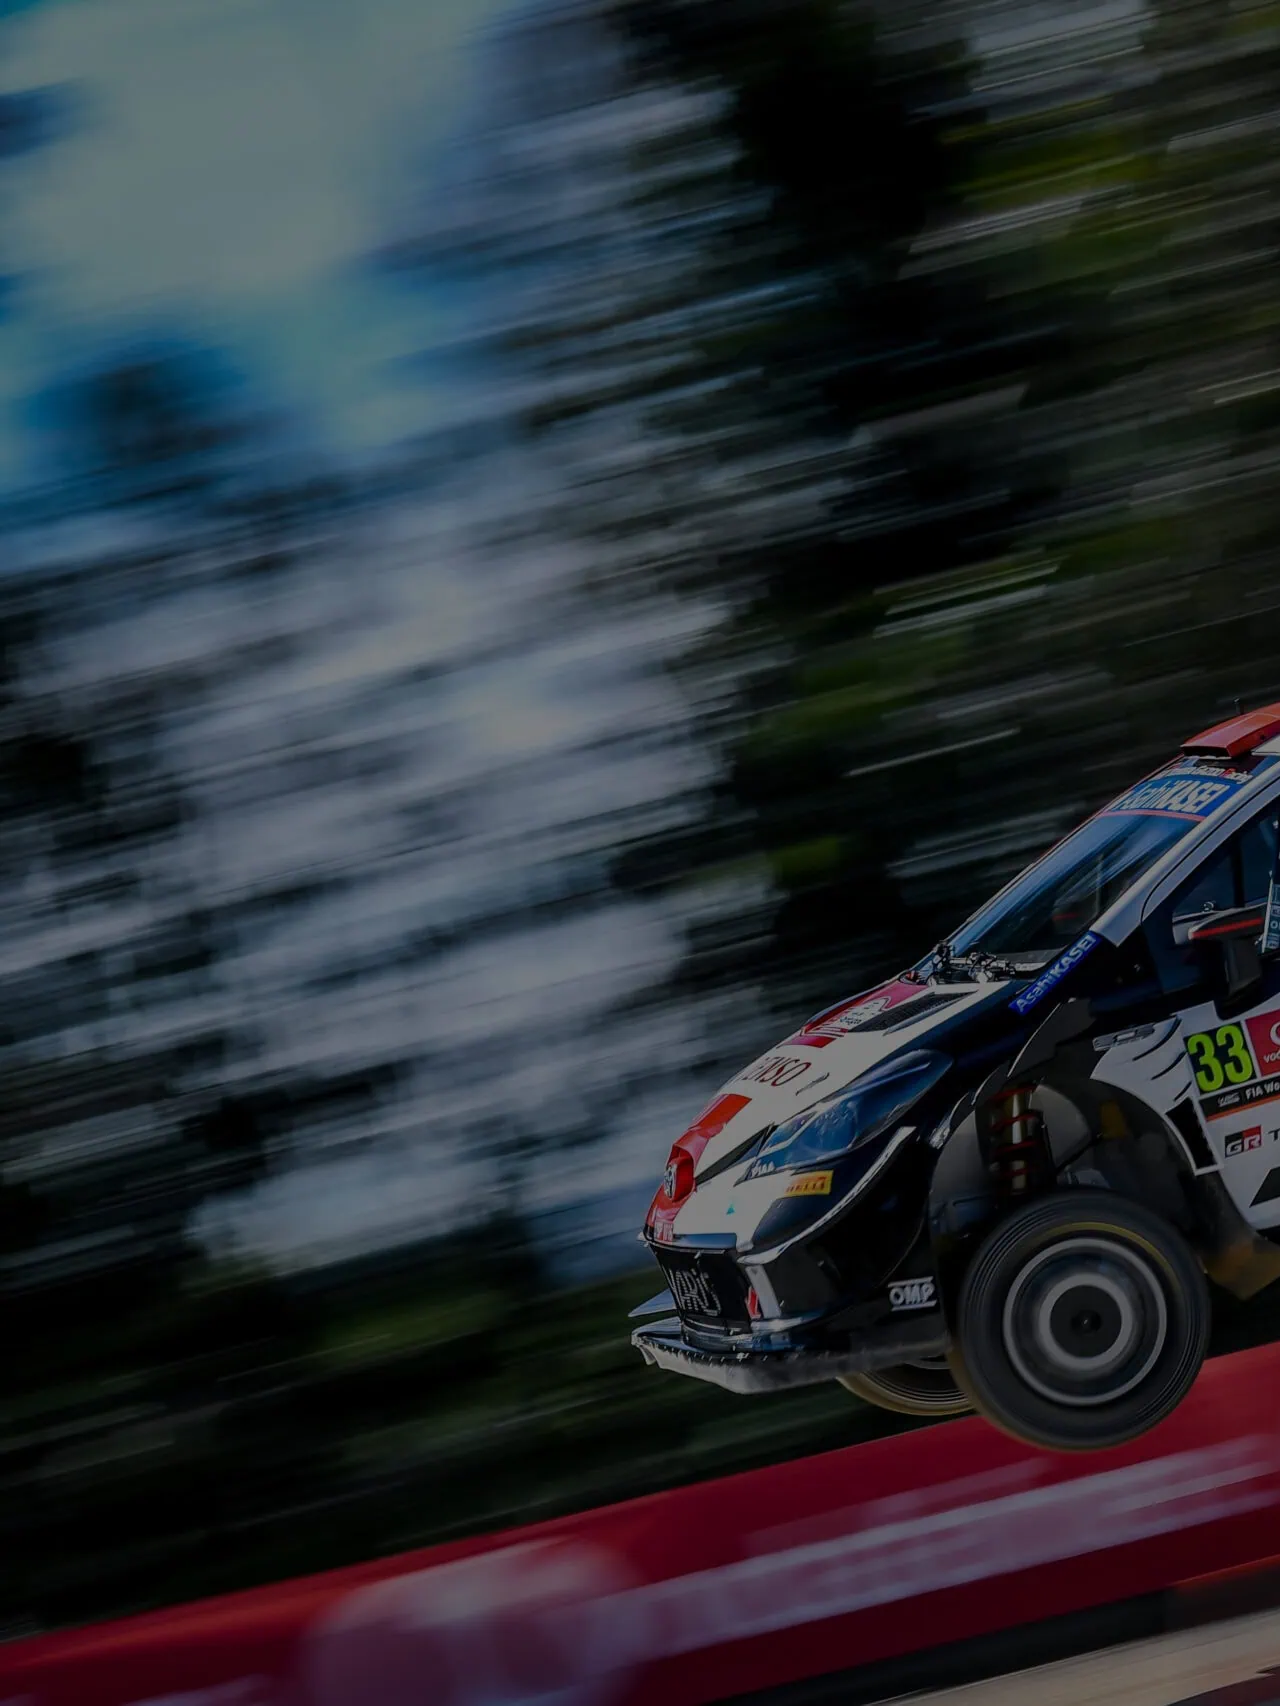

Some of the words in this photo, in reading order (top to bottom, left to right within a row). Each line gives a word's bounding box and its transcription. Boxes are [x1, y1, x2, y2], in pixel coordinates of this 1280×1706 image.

[1187, 1024, 1254, 1093] 33
[1246, 1087, 1264, 1101] FIA
[1225, 1134, 1262, 1157] GR
[888, 1281, 936, 1307] OMP
